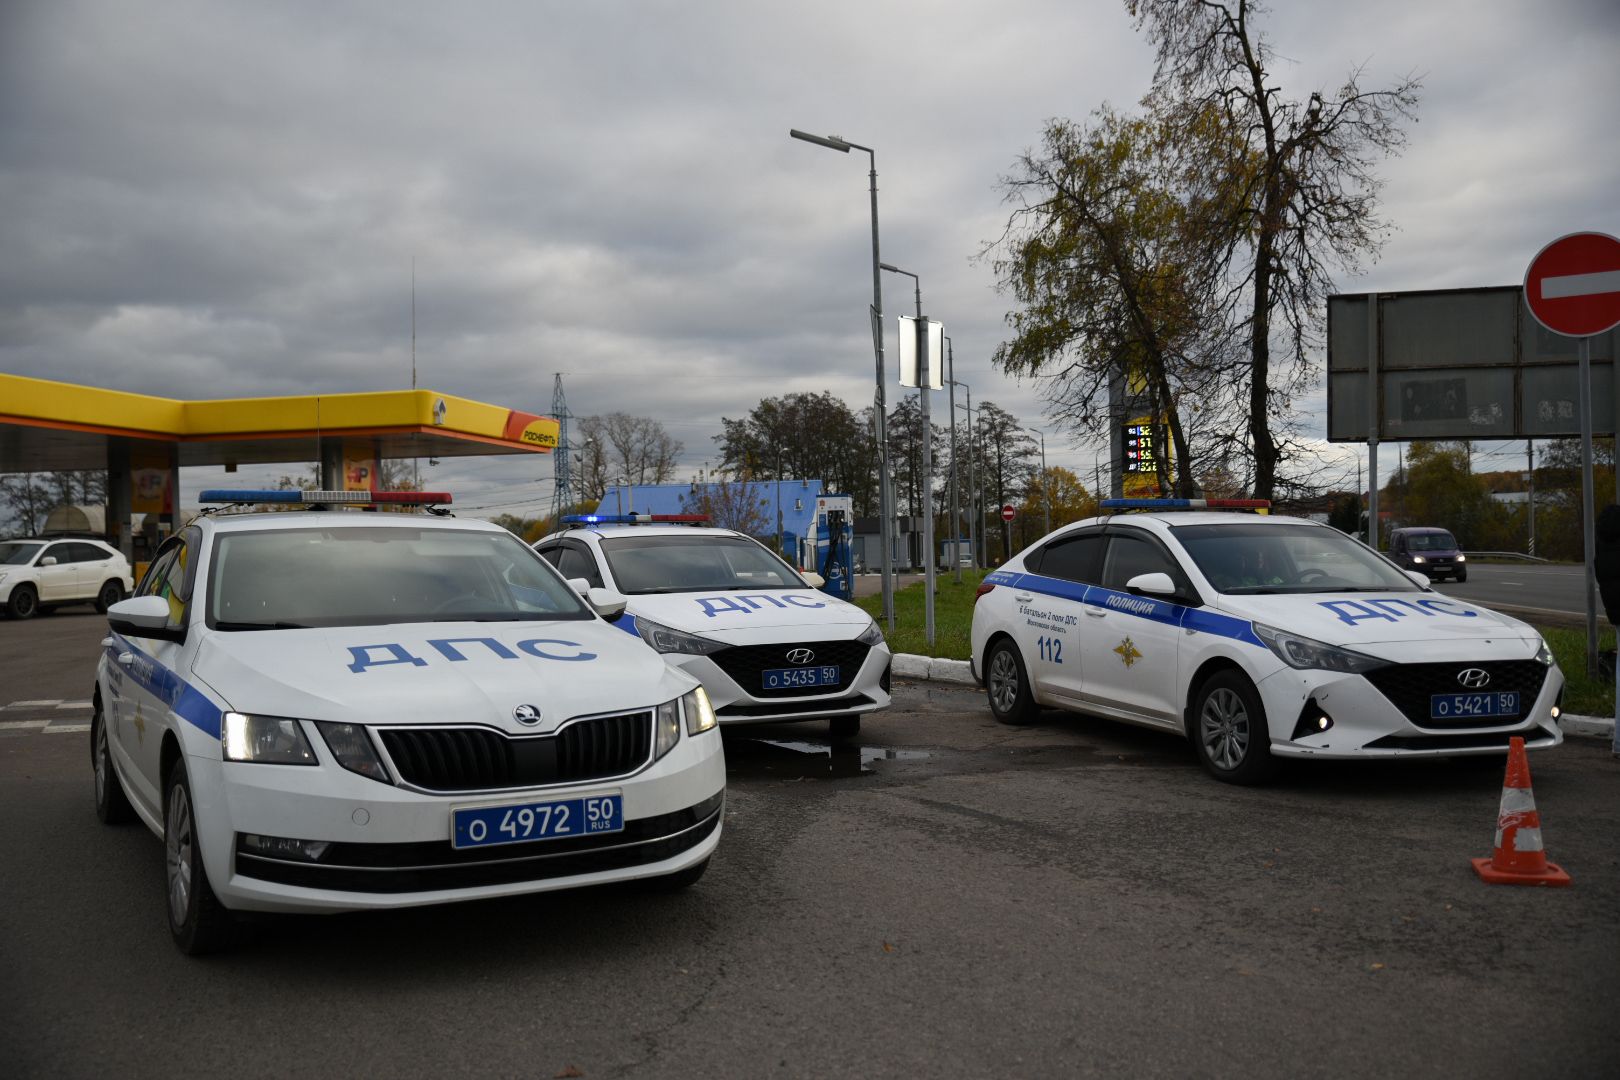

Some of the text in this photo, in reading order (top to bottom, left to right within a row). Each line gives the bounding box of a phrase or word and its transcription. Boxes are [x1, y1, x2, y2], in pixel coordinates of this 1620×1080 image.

[524, 431, 555, 444] РОСНЕФТЬ
[695, 595, 825, 617] ДПС
[1105, 594, 1156, 615] ПОЛИЦИЯ
[1316, 599, 1478, 626] ДПС
[1024, 606, 1047, 619] батальон
[1052, 614, 1064, 623] полк
[1065, 615, 1078, 626] ДПС
[347, 637, 597, 673] ДПС
[1037, 635, 1063, 664] 112
[783, 669, 816, 686] 5435
[823, 667, 835, 679] 50
[1454, 696, 1492, 715] 5421
[1500, 694, 1515, 708] 50
[499, 804, 571, 839] 4972
[587, 798, 614, 821] 50
[591, 820, 612, 831] RUS
